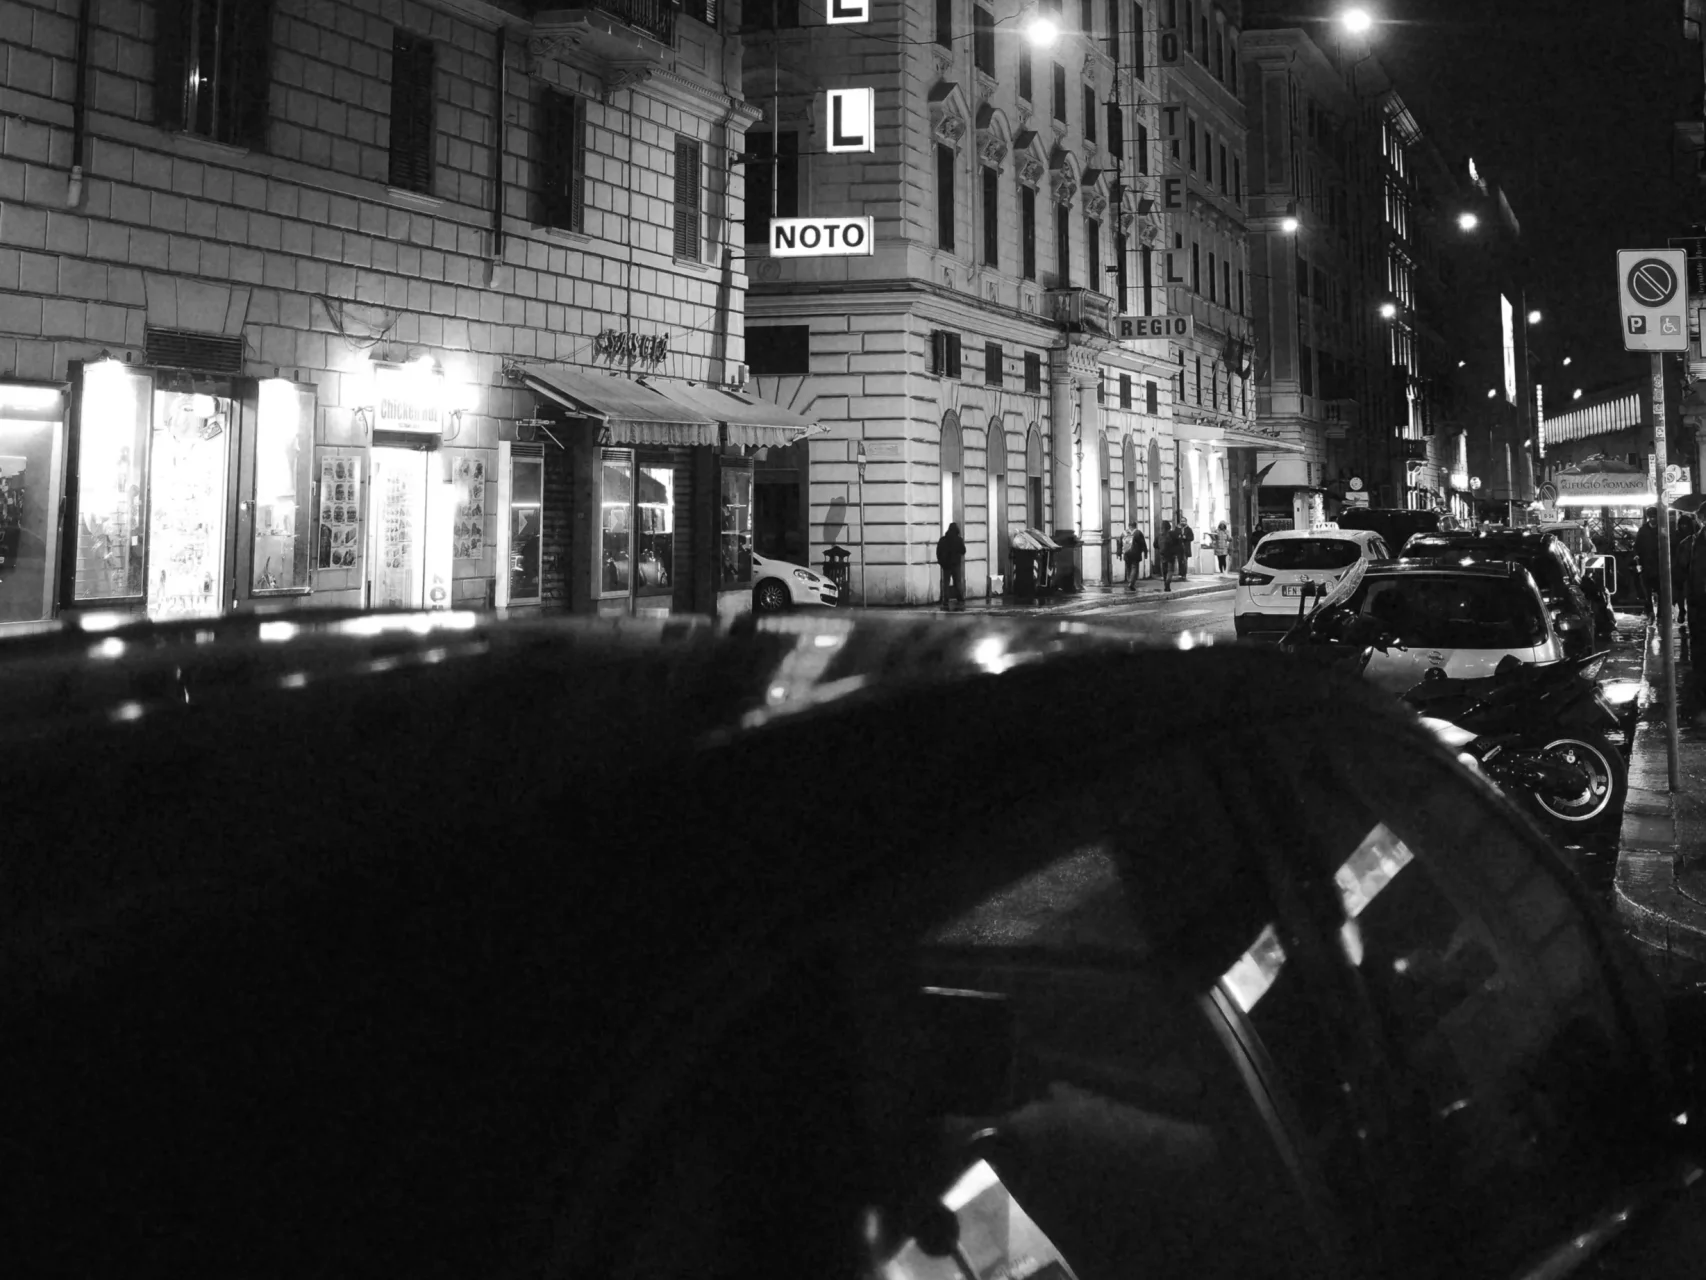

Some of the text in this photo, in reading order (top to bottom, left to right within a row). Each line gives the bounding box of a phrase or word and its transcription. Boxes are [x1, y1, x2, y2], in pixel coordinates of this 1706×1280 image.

[775, 223, 865, 249] NOTO
[1120, 317, 1187, 337] REGIO
[1630, 317, 1643, 333] P
[1561, 478, 1644, 490] RIFUGIO ROMANO
